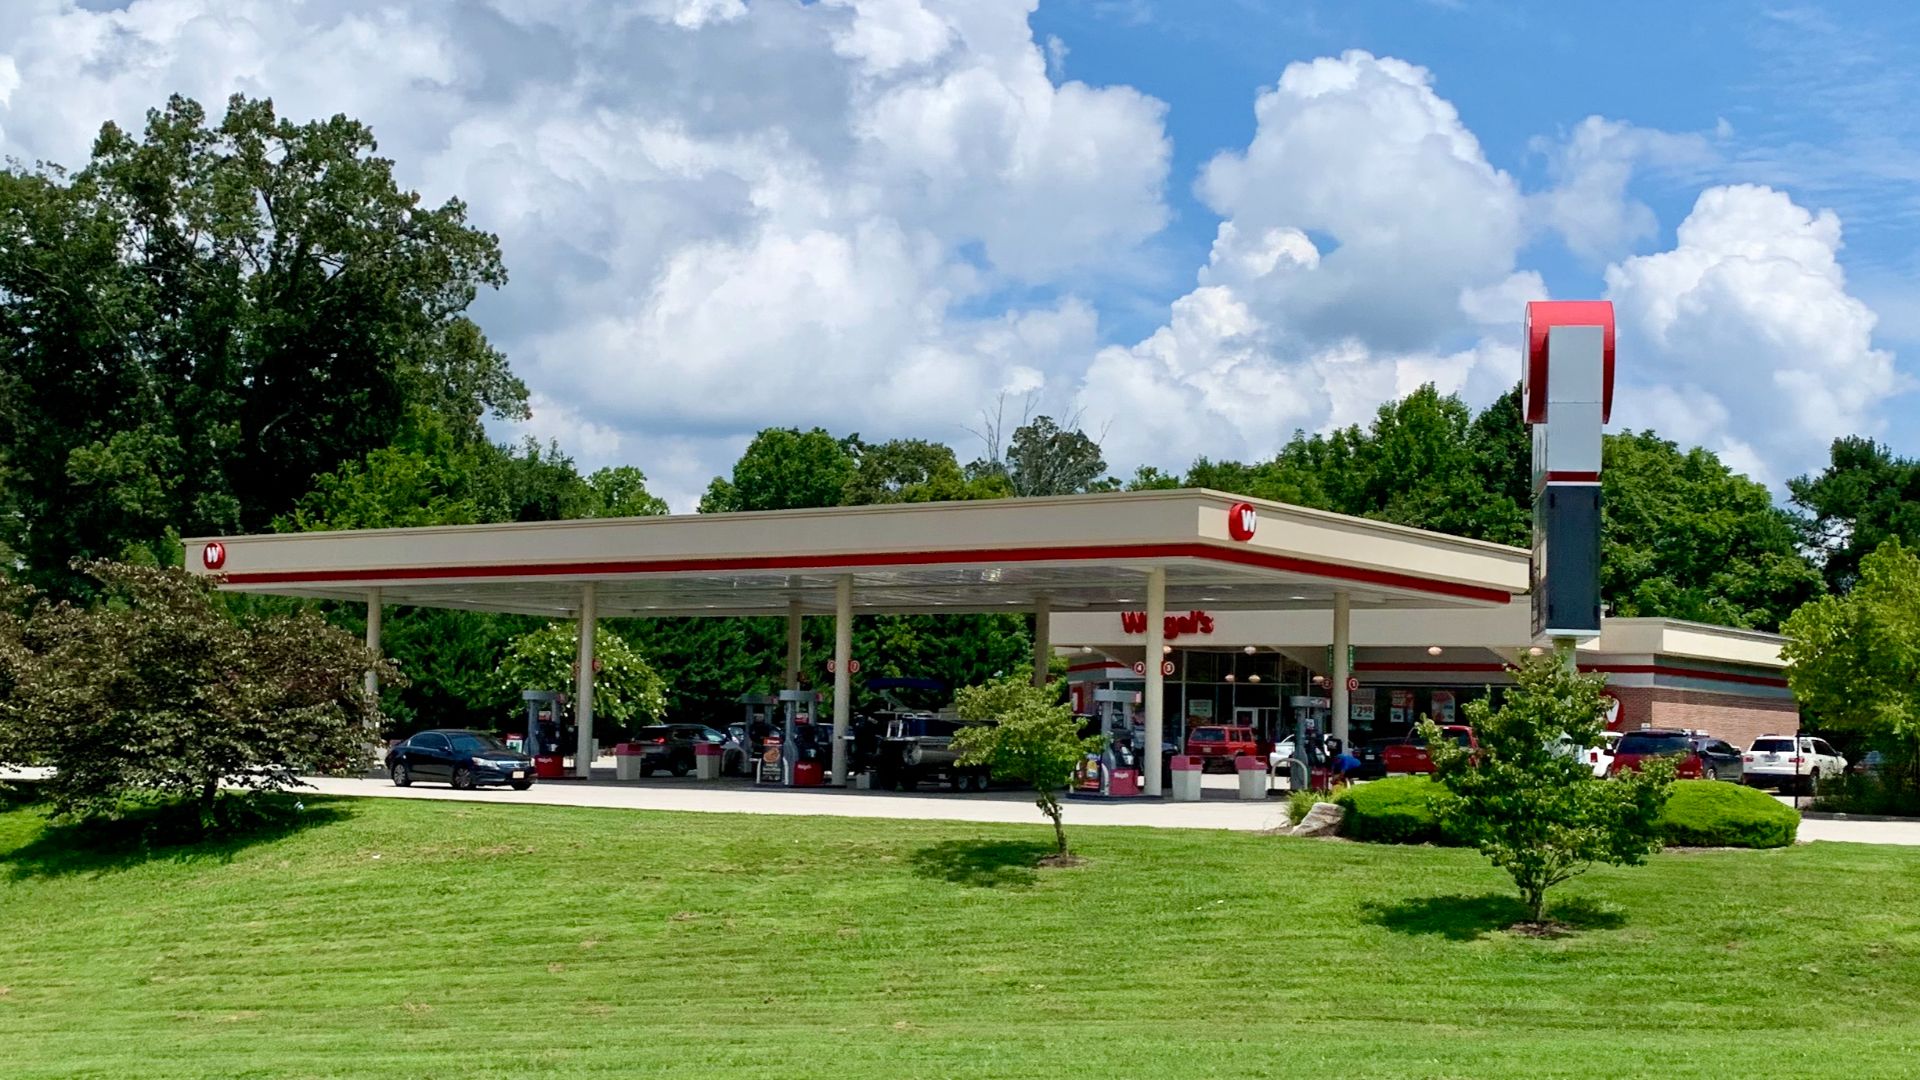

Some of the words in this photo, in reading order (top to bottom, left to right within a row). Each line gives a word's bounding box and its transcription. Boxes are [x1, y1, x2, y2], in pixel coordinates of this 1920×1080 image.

[1241, 509, 1256, 533] W
[206, 546, 219, 563] W
[1121, 610, 1214, 640] Wgel's
